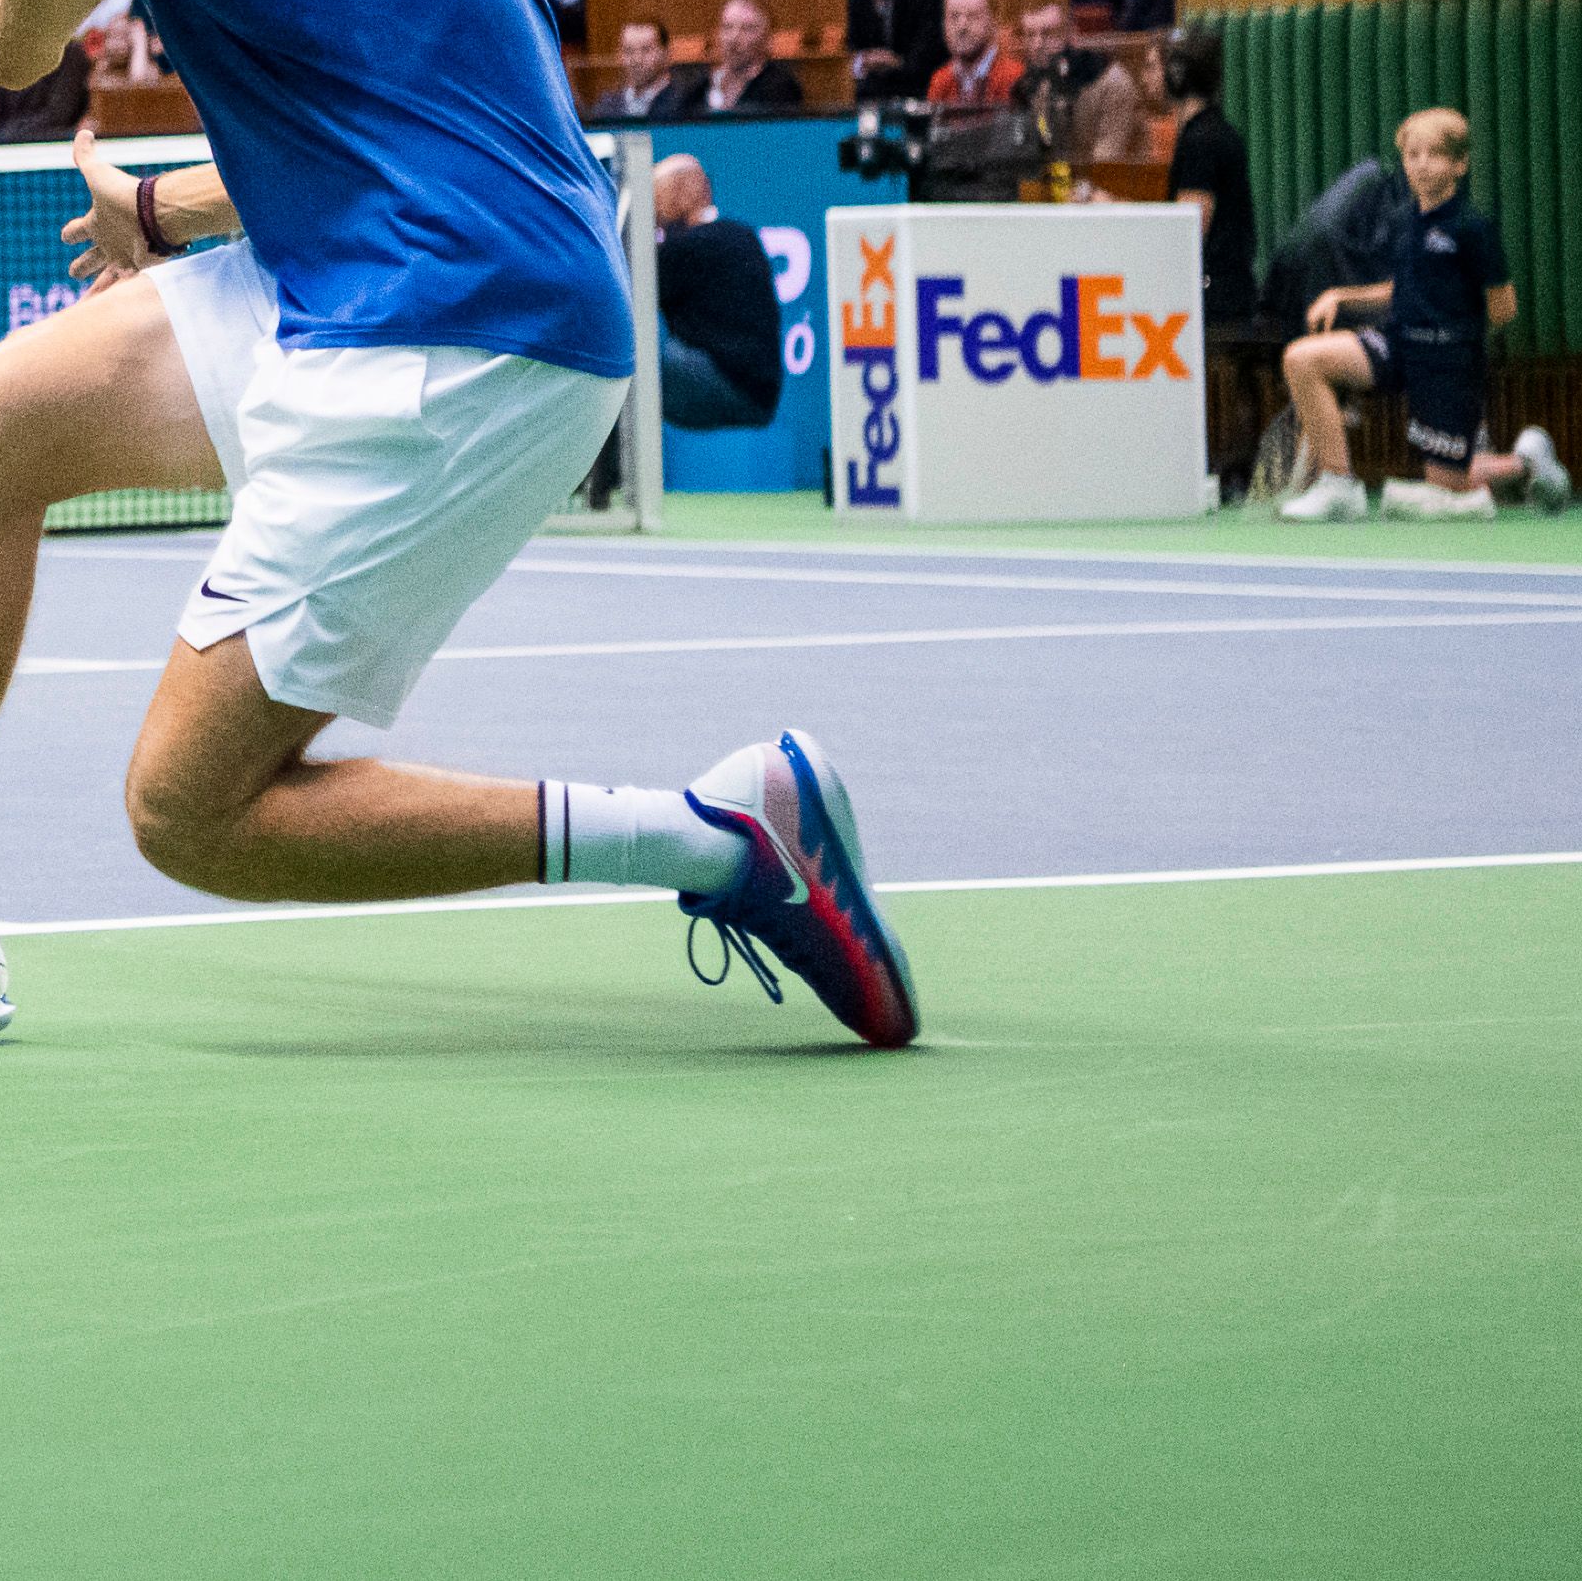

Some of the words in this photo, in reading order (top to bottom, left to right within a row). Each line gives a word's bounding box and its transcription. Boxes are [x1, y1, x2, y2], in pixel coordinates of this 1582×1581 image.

[8, 283, 93, 330] BO
[916, 275, 1191, 386] FedEx
[841, 234, 901, 510] FedEx
